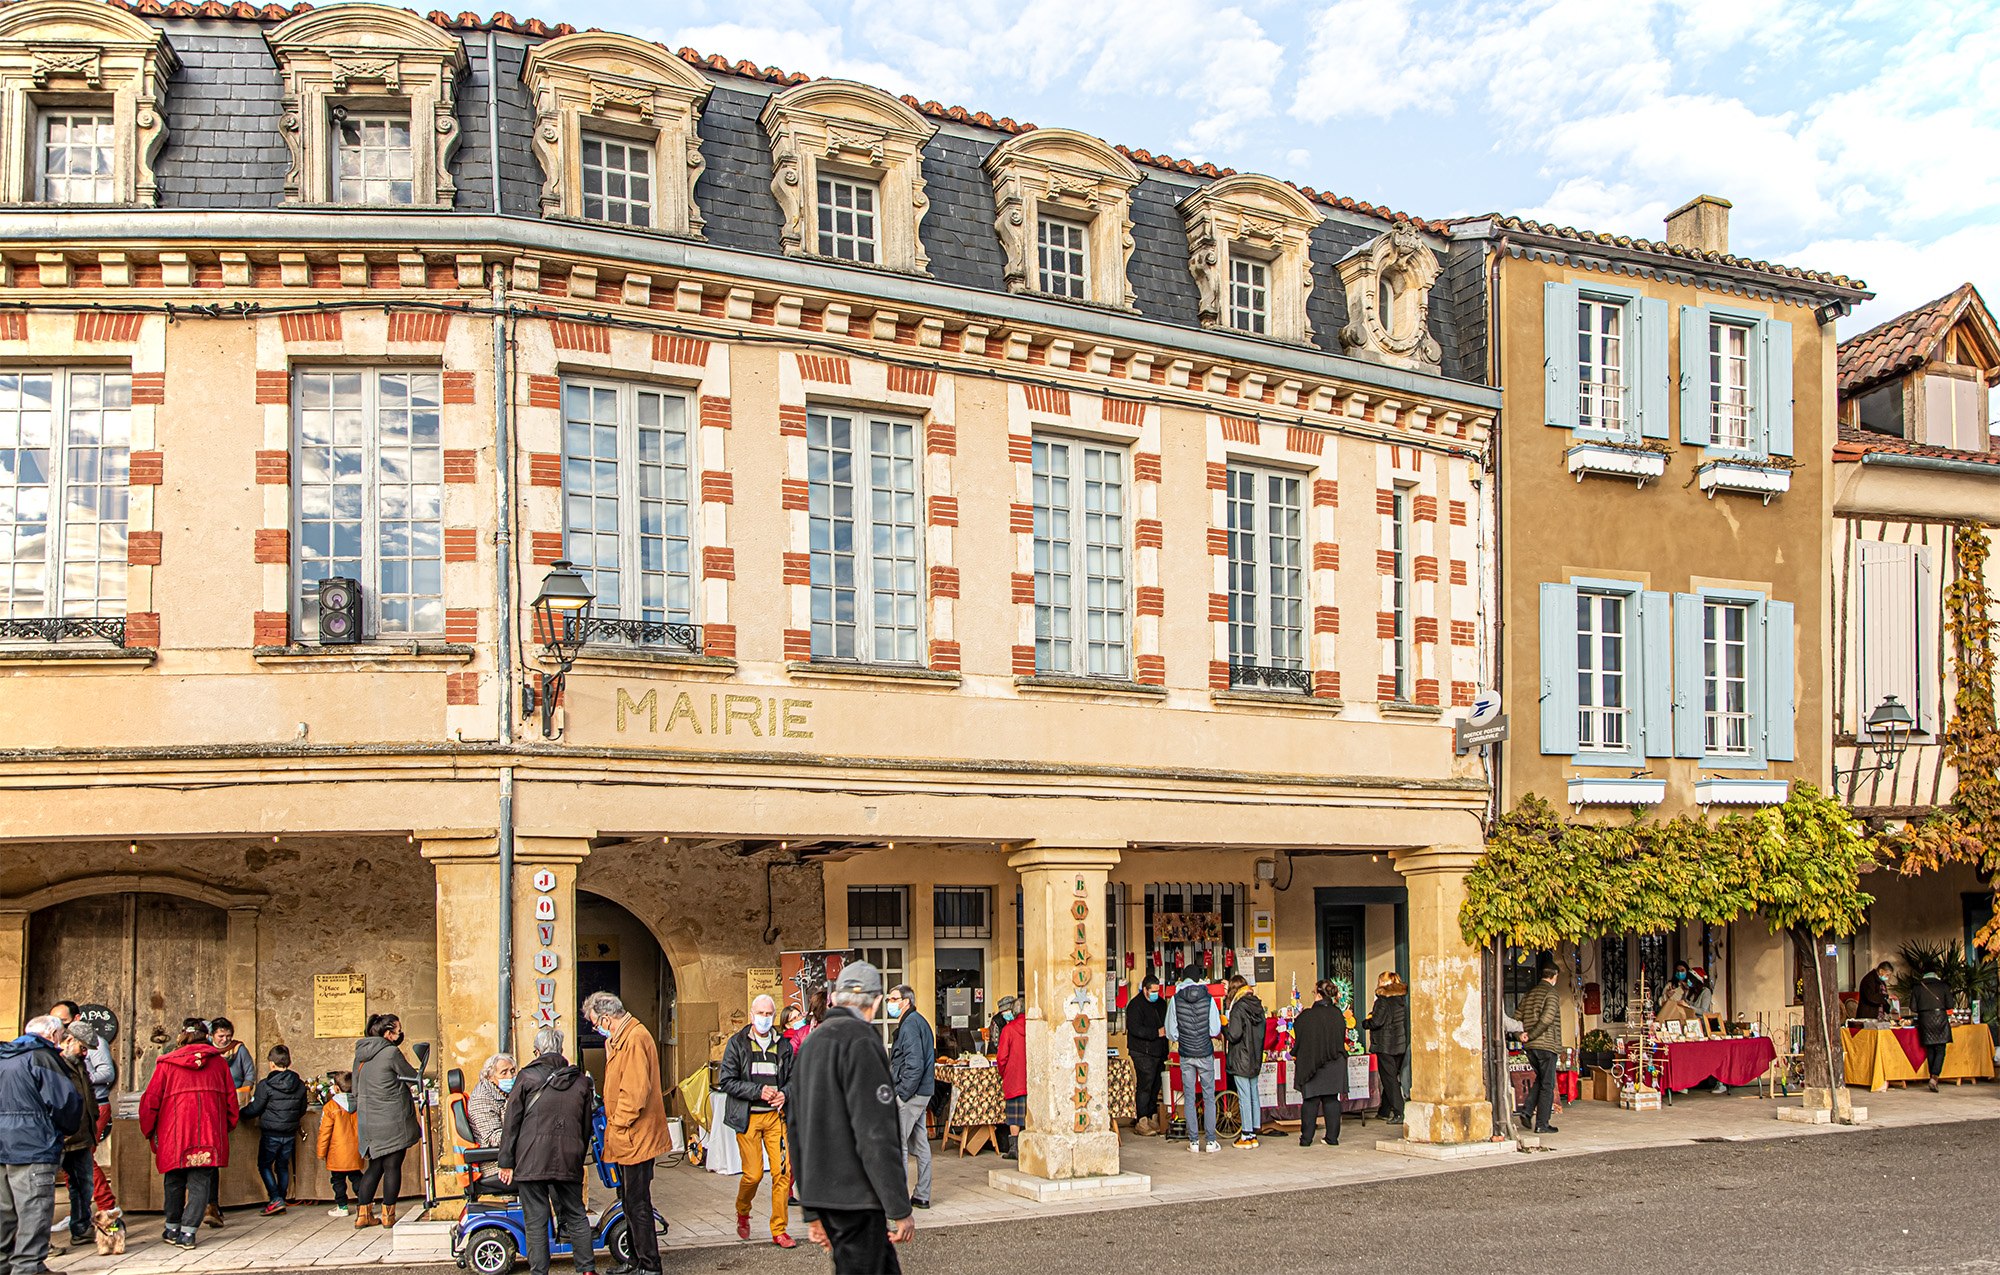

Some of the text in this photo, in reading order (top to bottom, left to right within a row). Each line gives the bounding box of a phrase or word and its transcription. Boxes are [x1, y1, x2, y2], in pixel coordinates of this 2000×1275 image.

[616, 687, 814, 738] MAIRIE
[1463, 726, 1505, 739] AGENCE POSTALE
[1469, 732, 1499, 743] COMMUNALE
[1076, 880, 1088, 983] BONNE
[539, 874, 552, 1021] JOYEUX
[80, 1010, 111, 1021] APAS
[1509, 1064, 1525, 1072] SERIE
